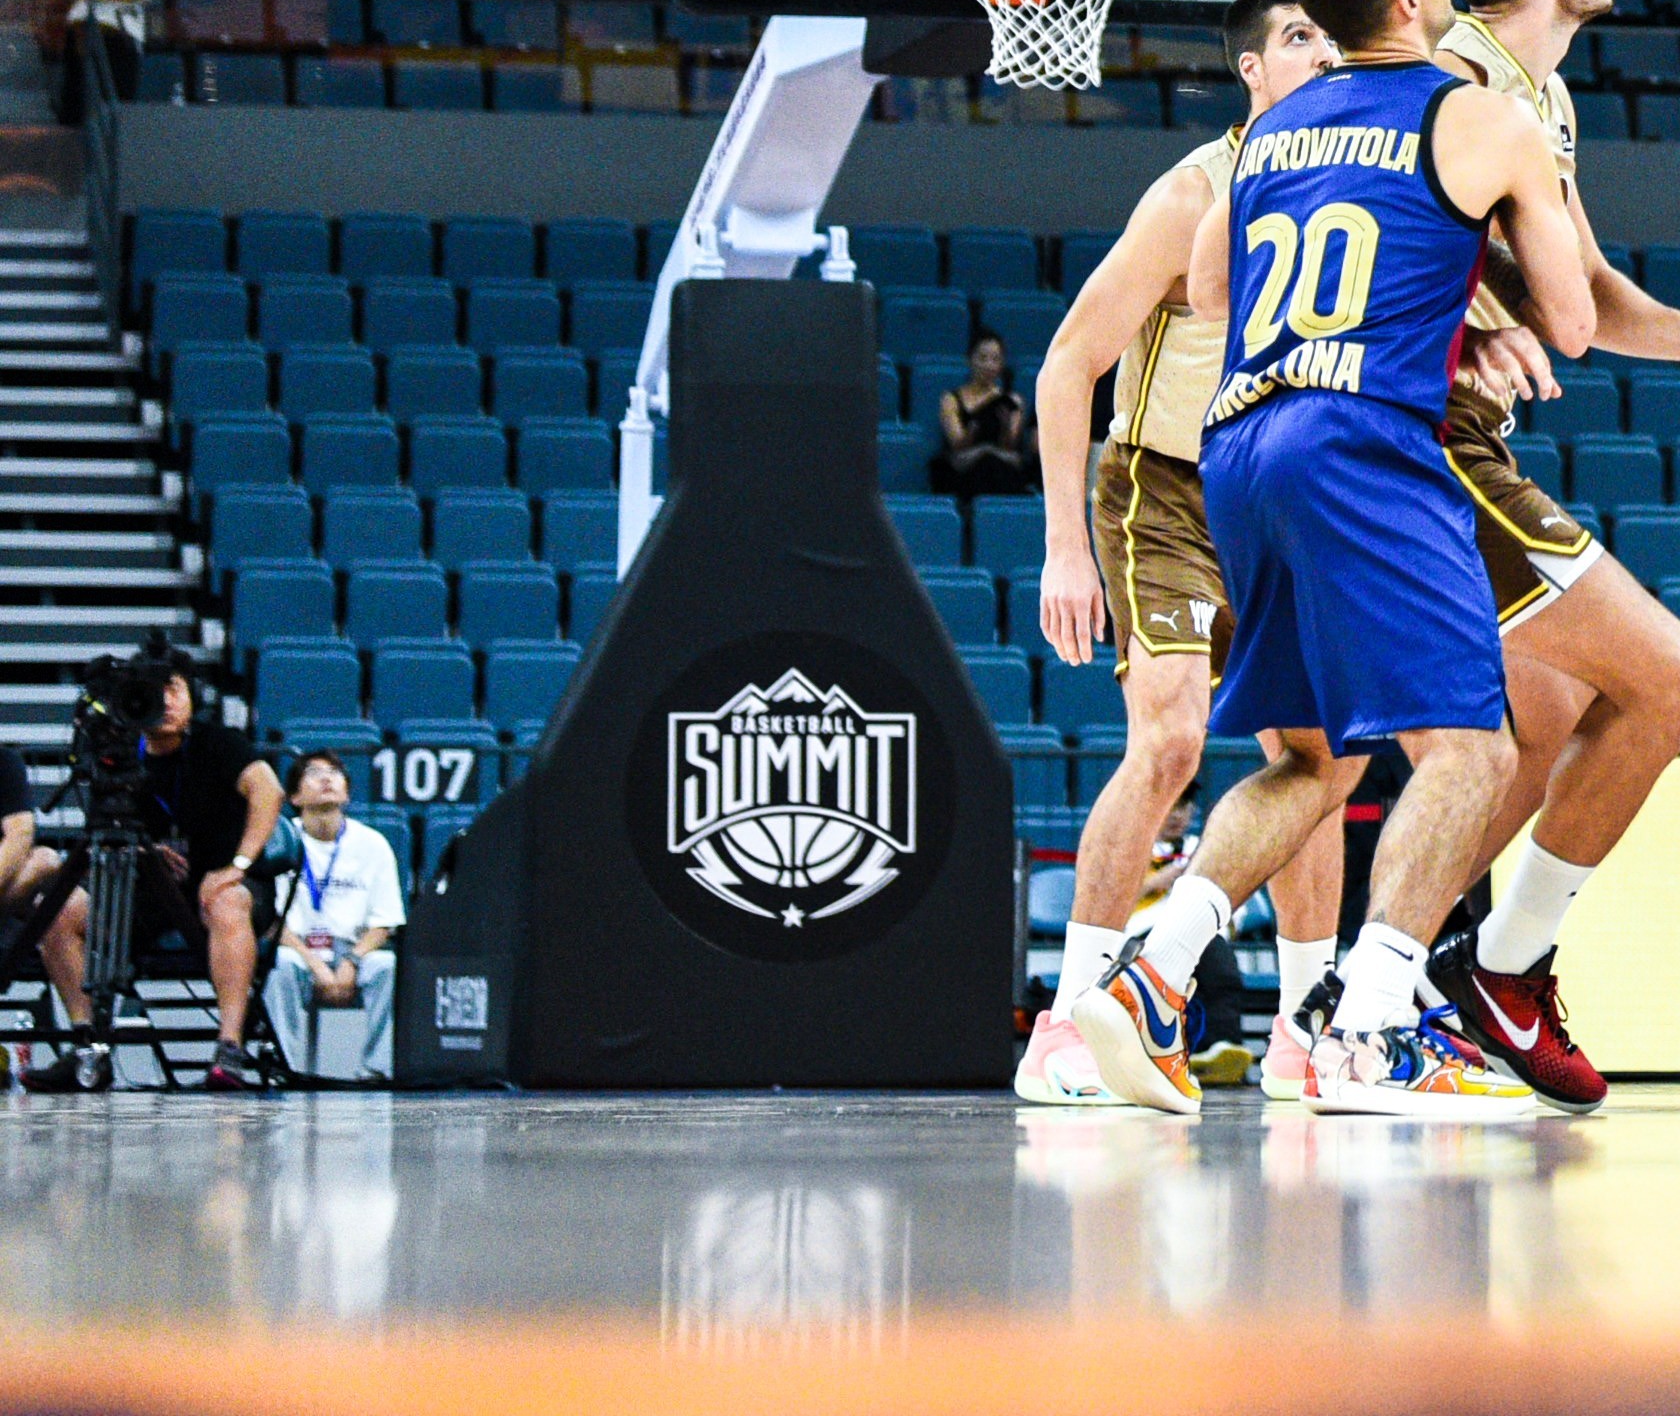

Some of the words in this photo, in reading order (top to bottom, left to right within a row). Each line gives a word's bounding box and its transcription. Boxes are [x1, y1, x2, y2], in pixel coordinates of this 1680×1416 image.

[1236, 126, 1420, 184] LAPROVITTOLA
[1243, 202, 1380, 360] 20
[1206, 340, 1366, 427] ARCELONA
[731, 715, 857, 734] BASKETBALL
[373, 748, 475, 801] 107
[684, 723, 905, 833] SUMMIT
